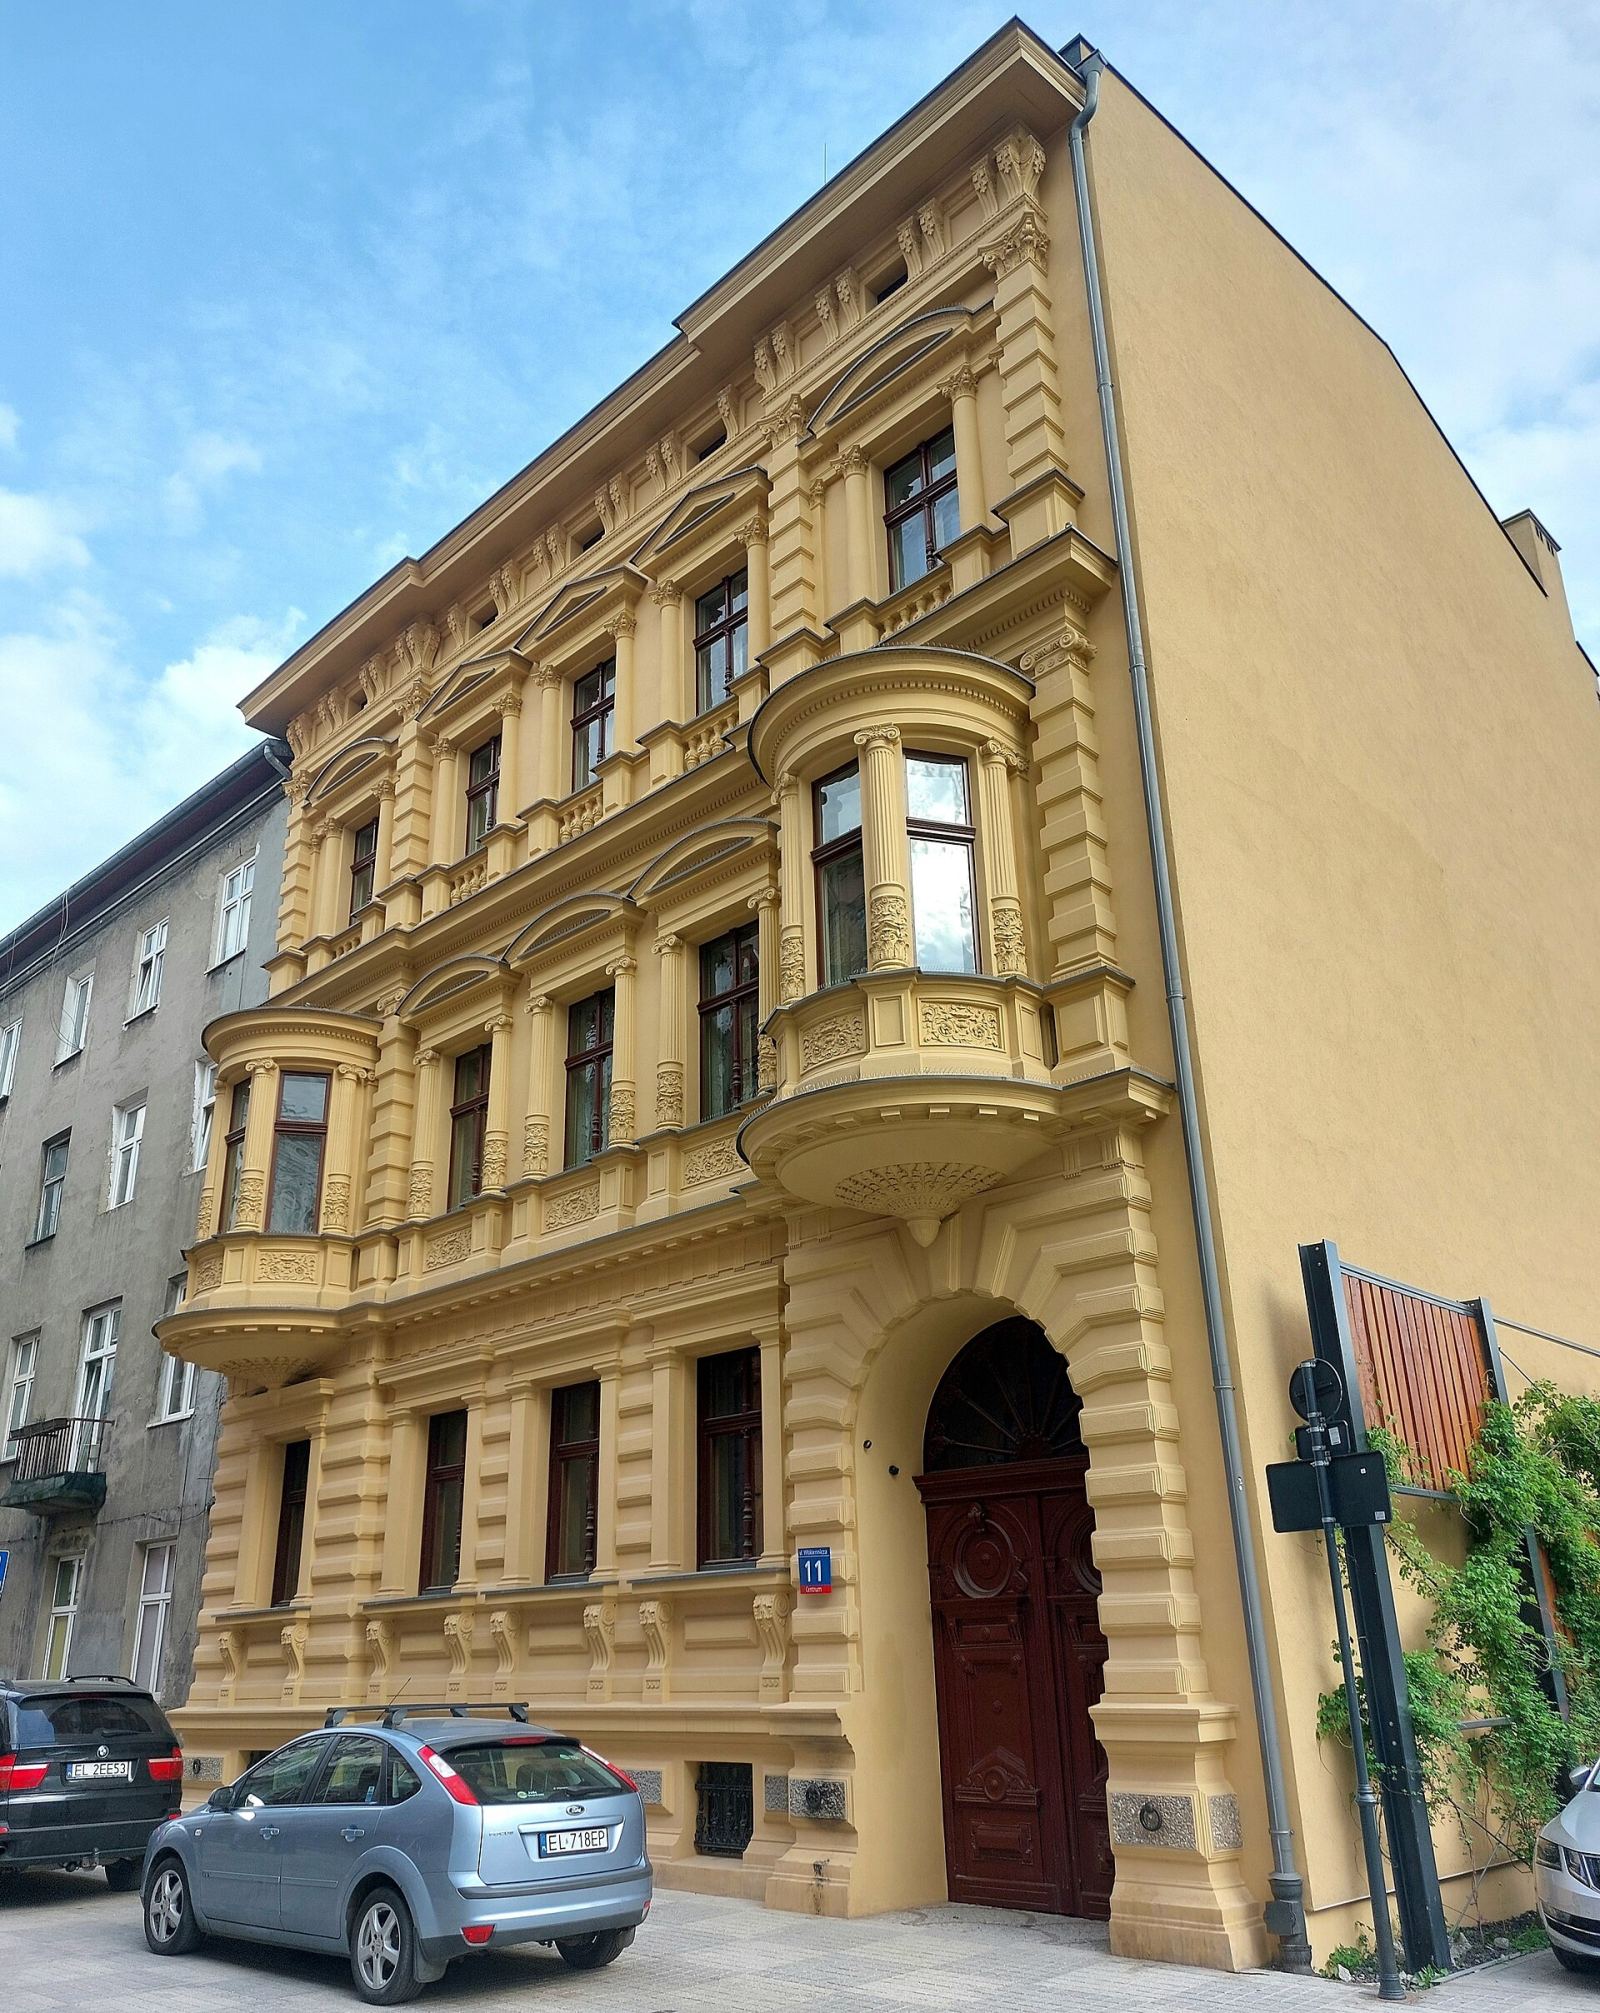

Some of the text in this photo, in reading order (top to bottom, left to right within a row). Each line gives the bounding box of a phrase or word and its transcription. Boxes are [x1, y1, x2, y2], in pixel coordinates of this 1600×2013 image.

[804, 1560, 822, 1582] 11
[75, 1763, 126, 1776] EL 2EE53
[548, 1830, 605, 1851] EL 718EP
